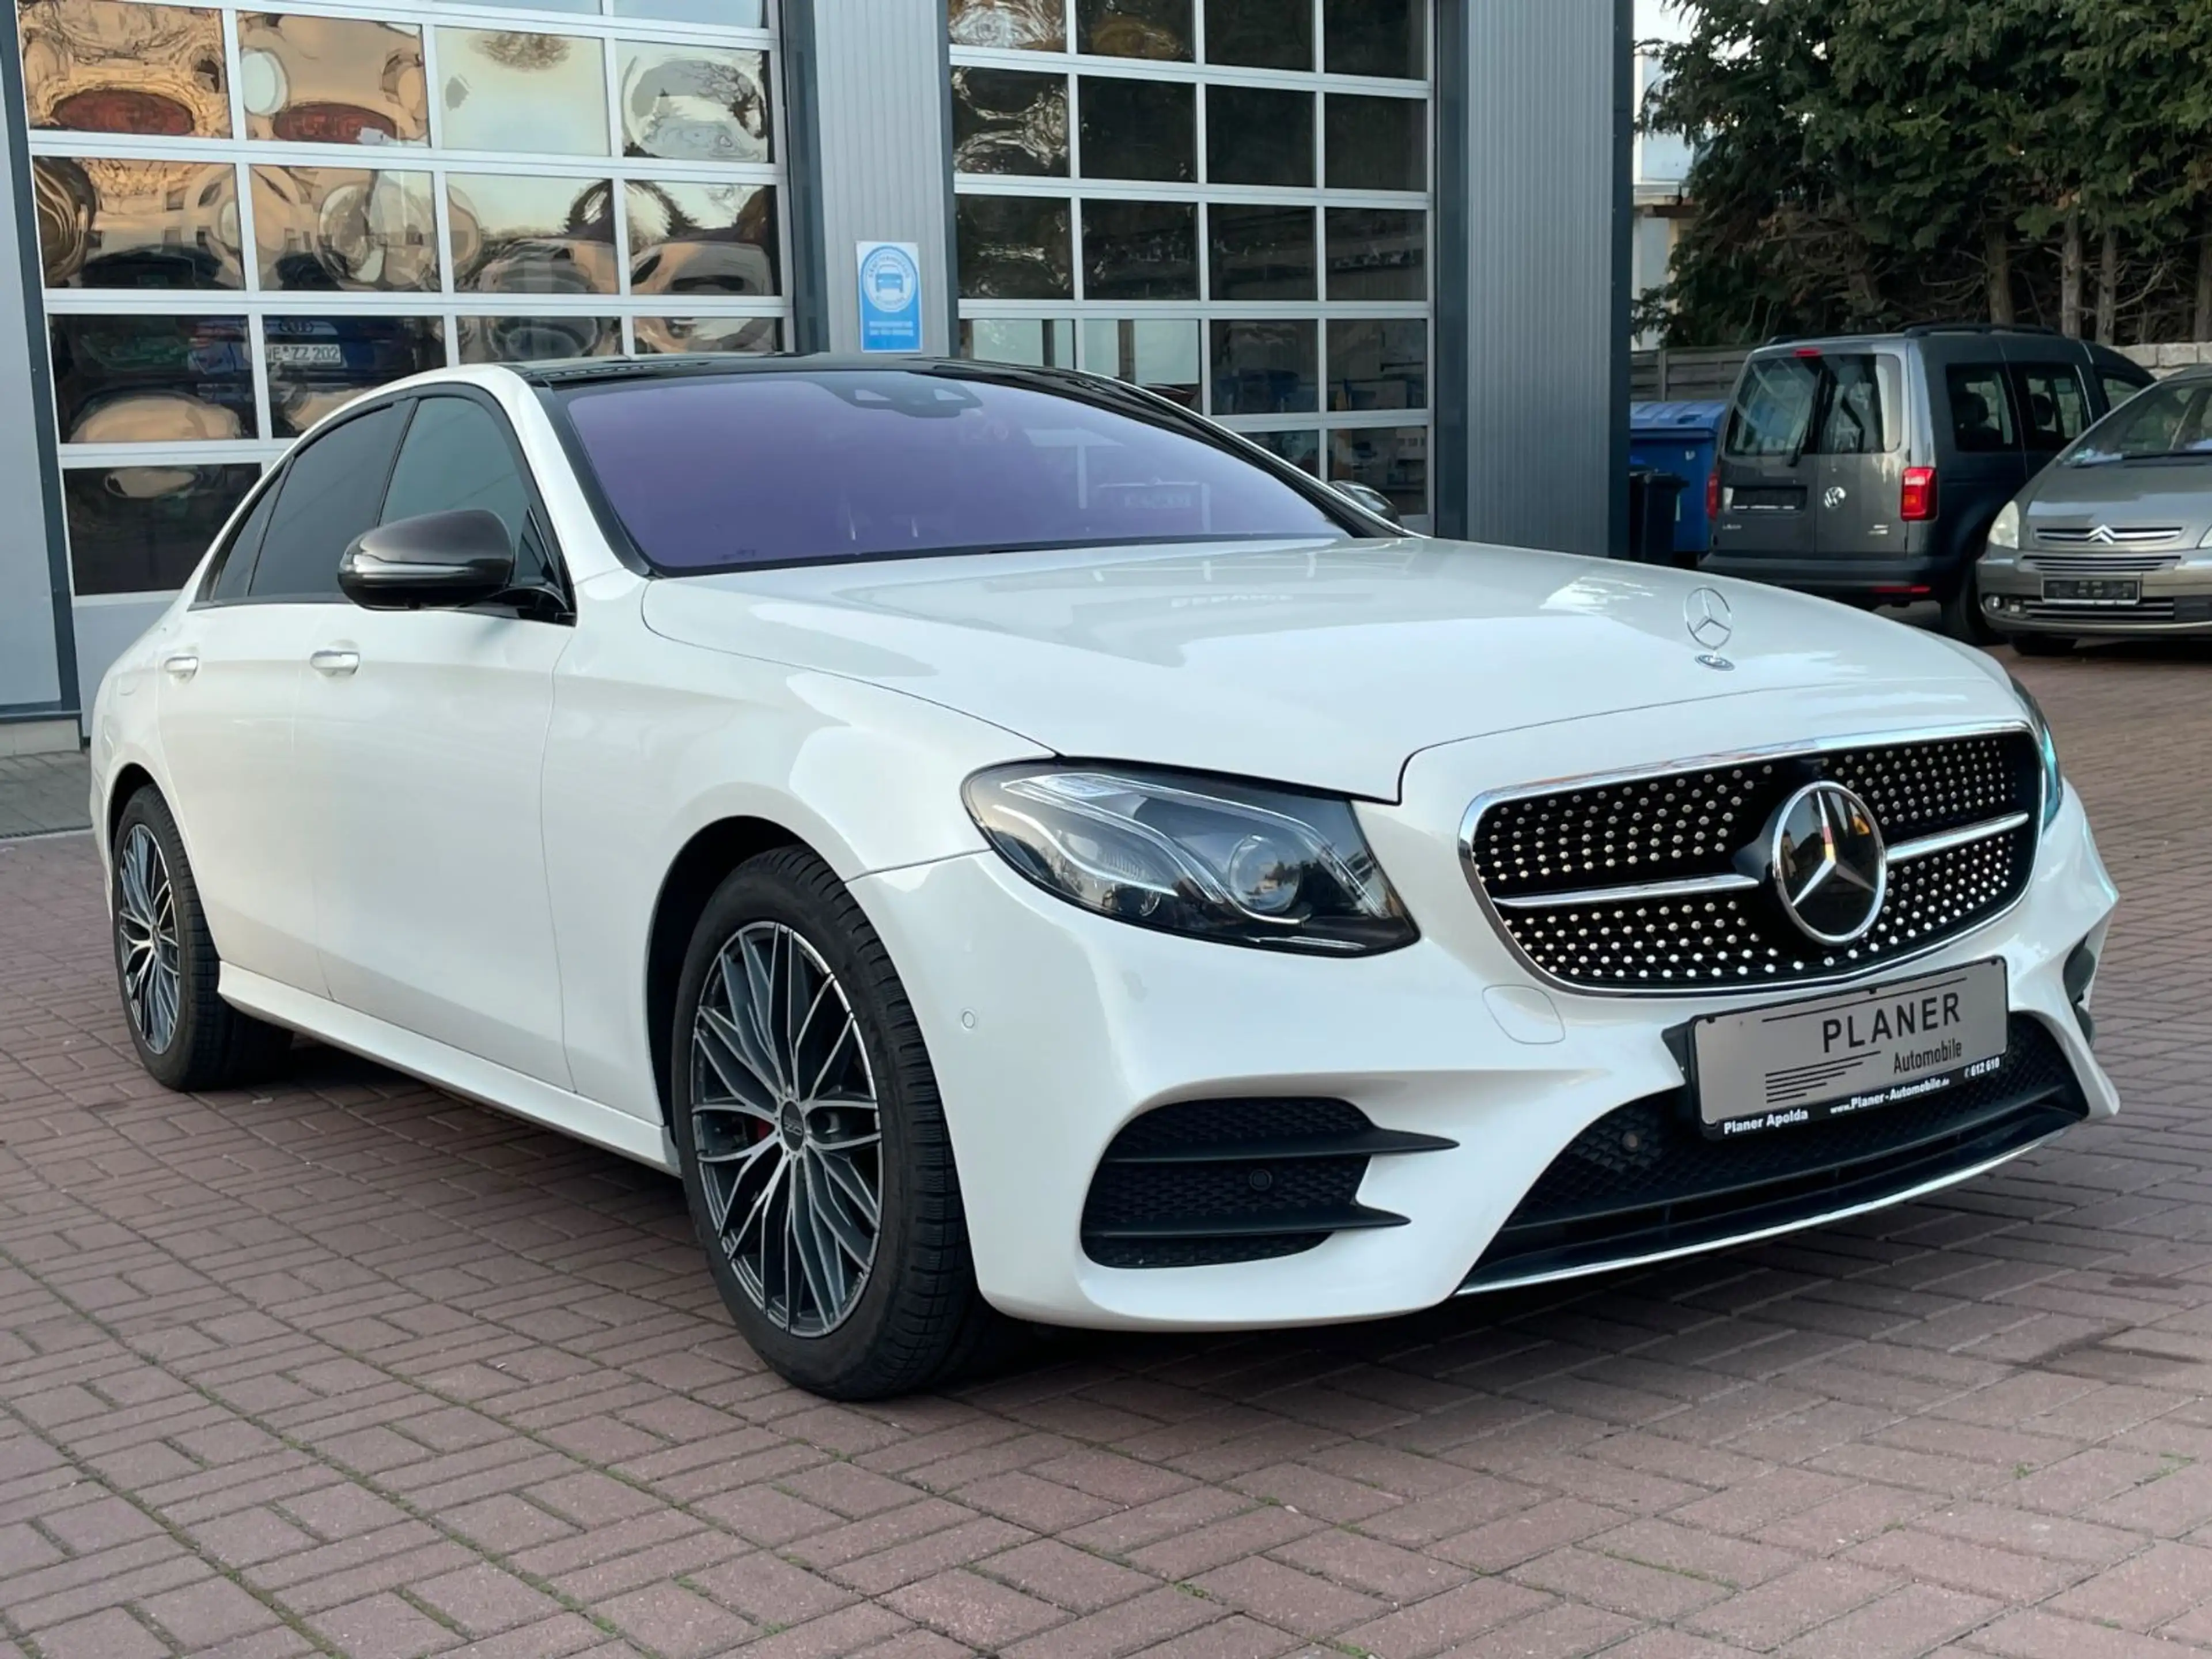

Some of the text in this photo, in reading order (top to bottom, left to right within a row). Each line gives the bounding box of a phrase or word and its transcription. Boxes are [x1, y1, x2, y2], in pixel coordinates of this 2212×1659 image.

[312, 346, 339, 361] 202
[1823, 992, 1960, 1053] PLANER
[1893, 1037, 1962, 1074] Automobile
[1830, 1077, 1950, 1114] www.Planer-Automobile.de
[1724, 1108, 1808, 1134] Planer Apolda
